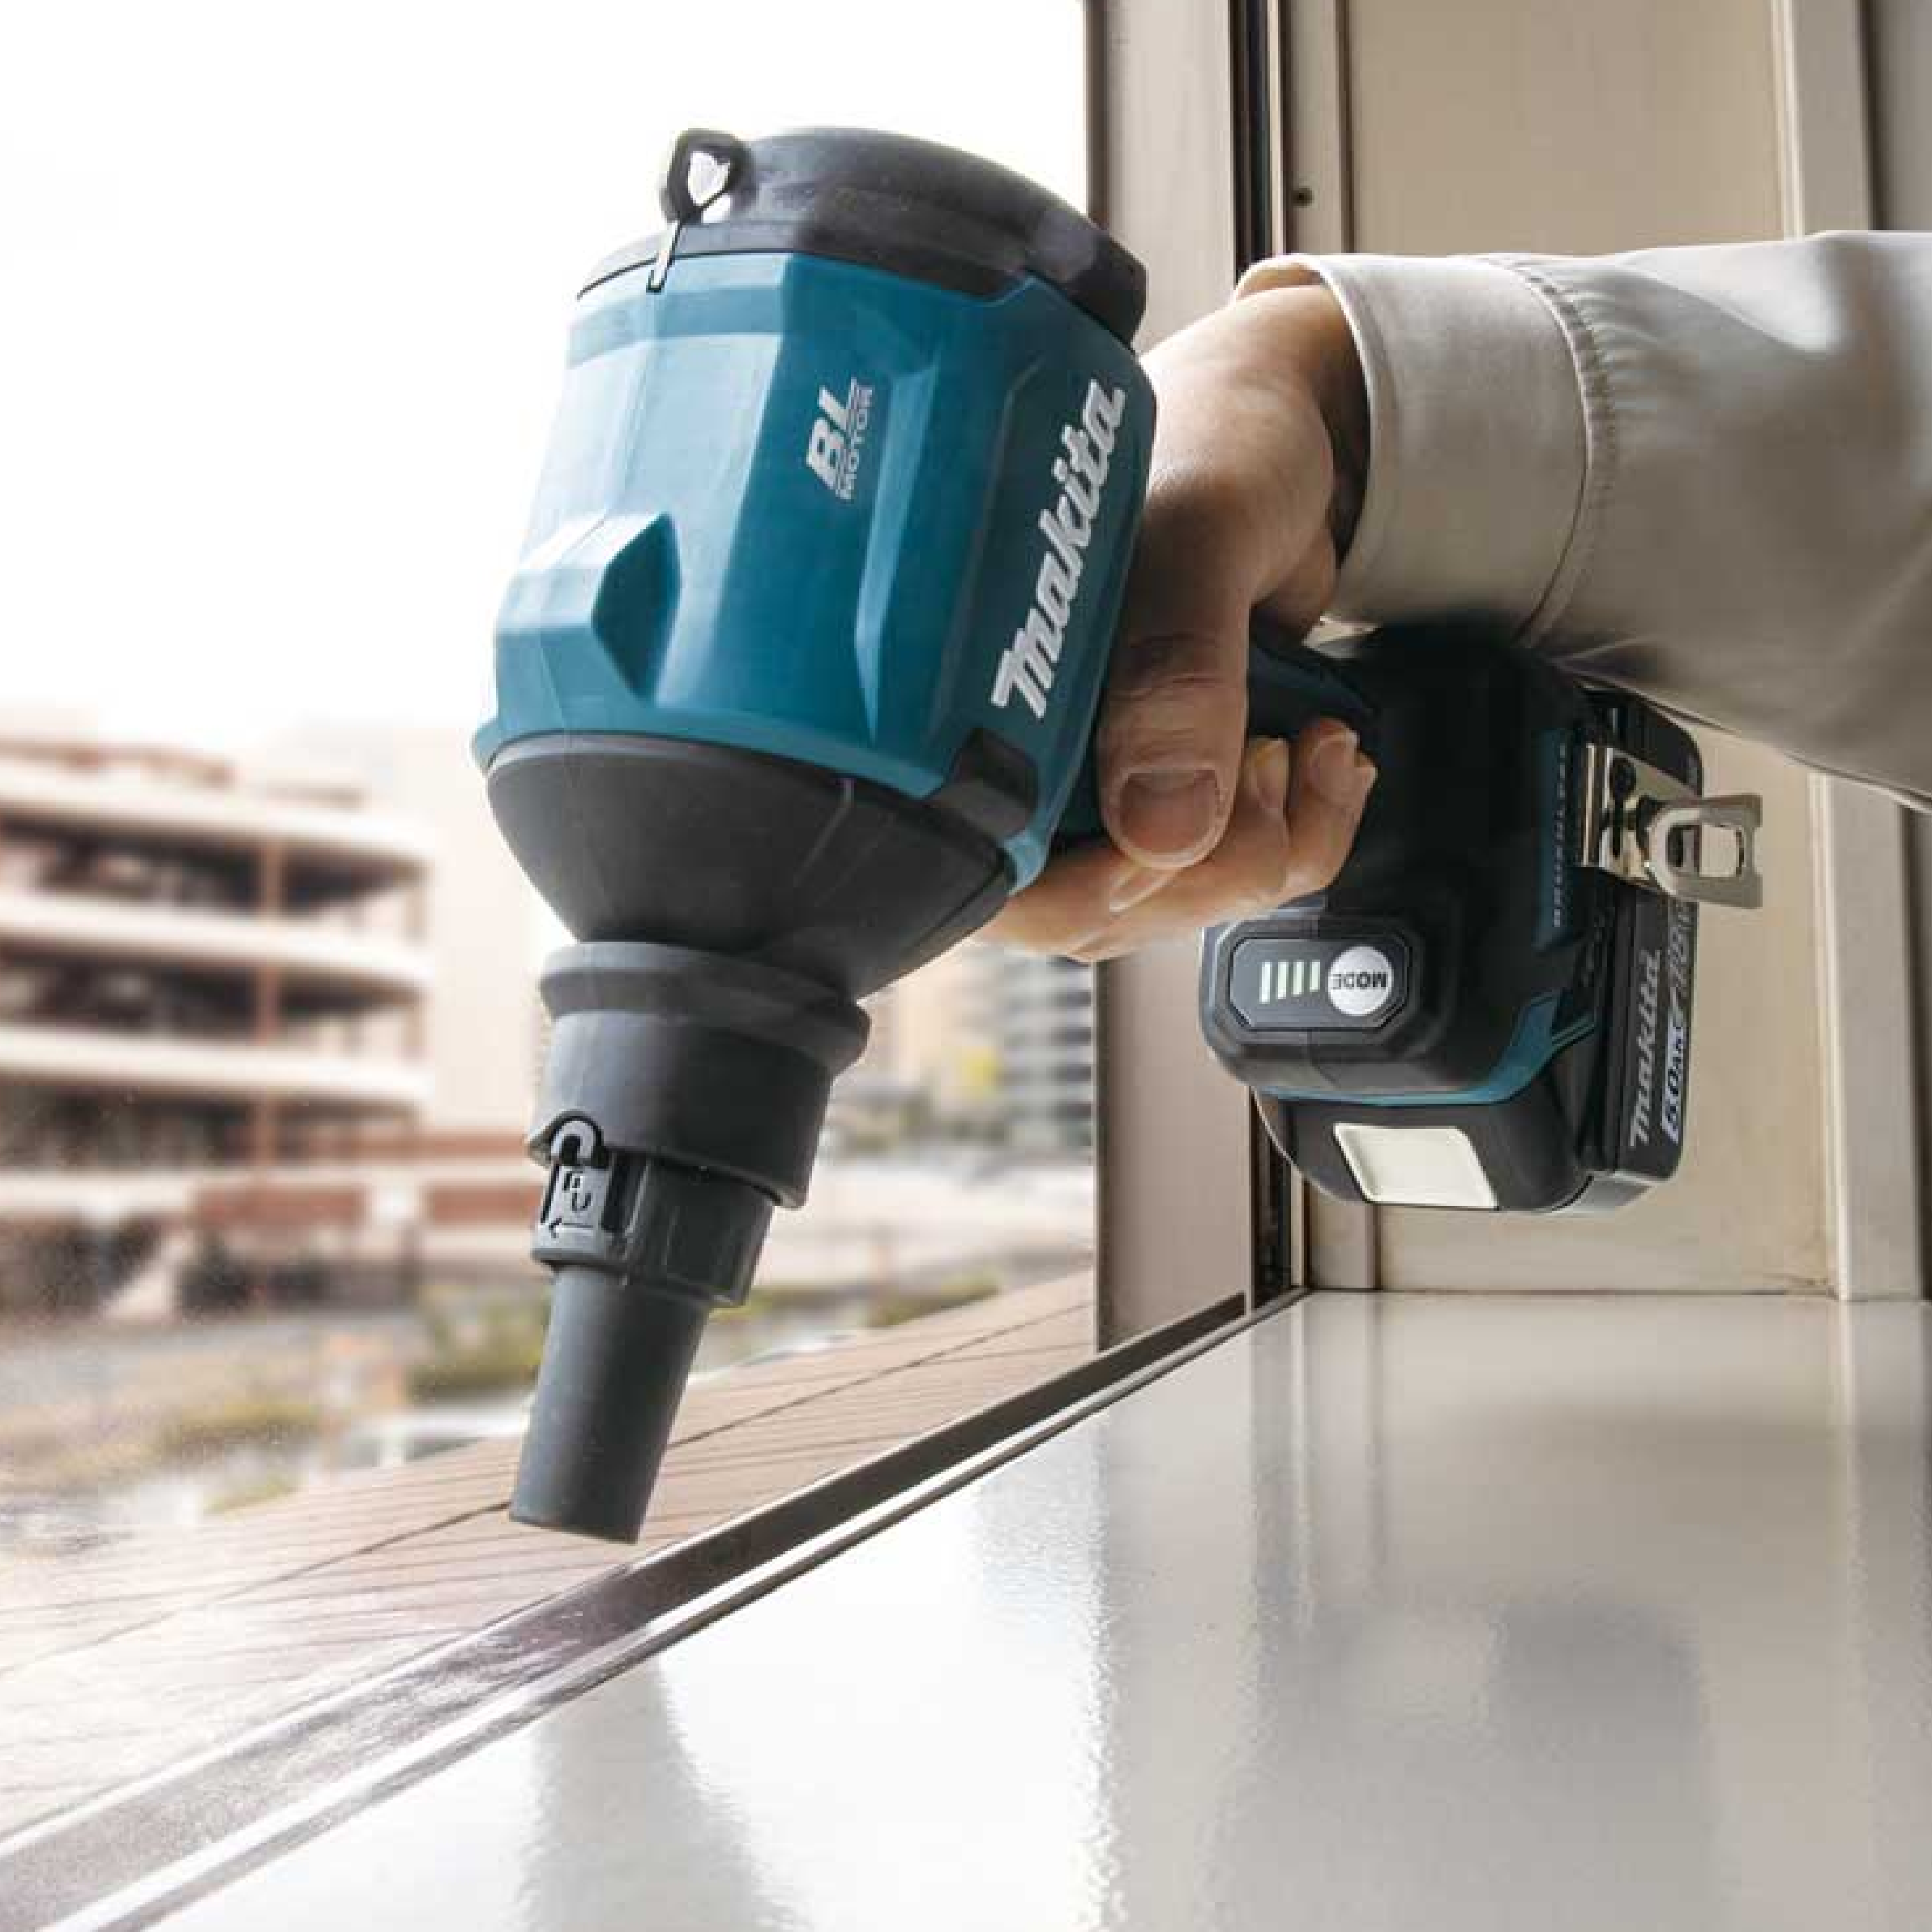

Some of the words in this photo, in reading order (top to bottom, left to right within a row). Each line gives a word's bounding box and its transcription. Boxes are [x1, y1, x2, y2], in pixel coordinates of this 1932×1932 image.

[806, 378, 856, 491] BL
[836, 386, 873, 499] MOTOR
[1331, 971, 1387, 990] MODE
